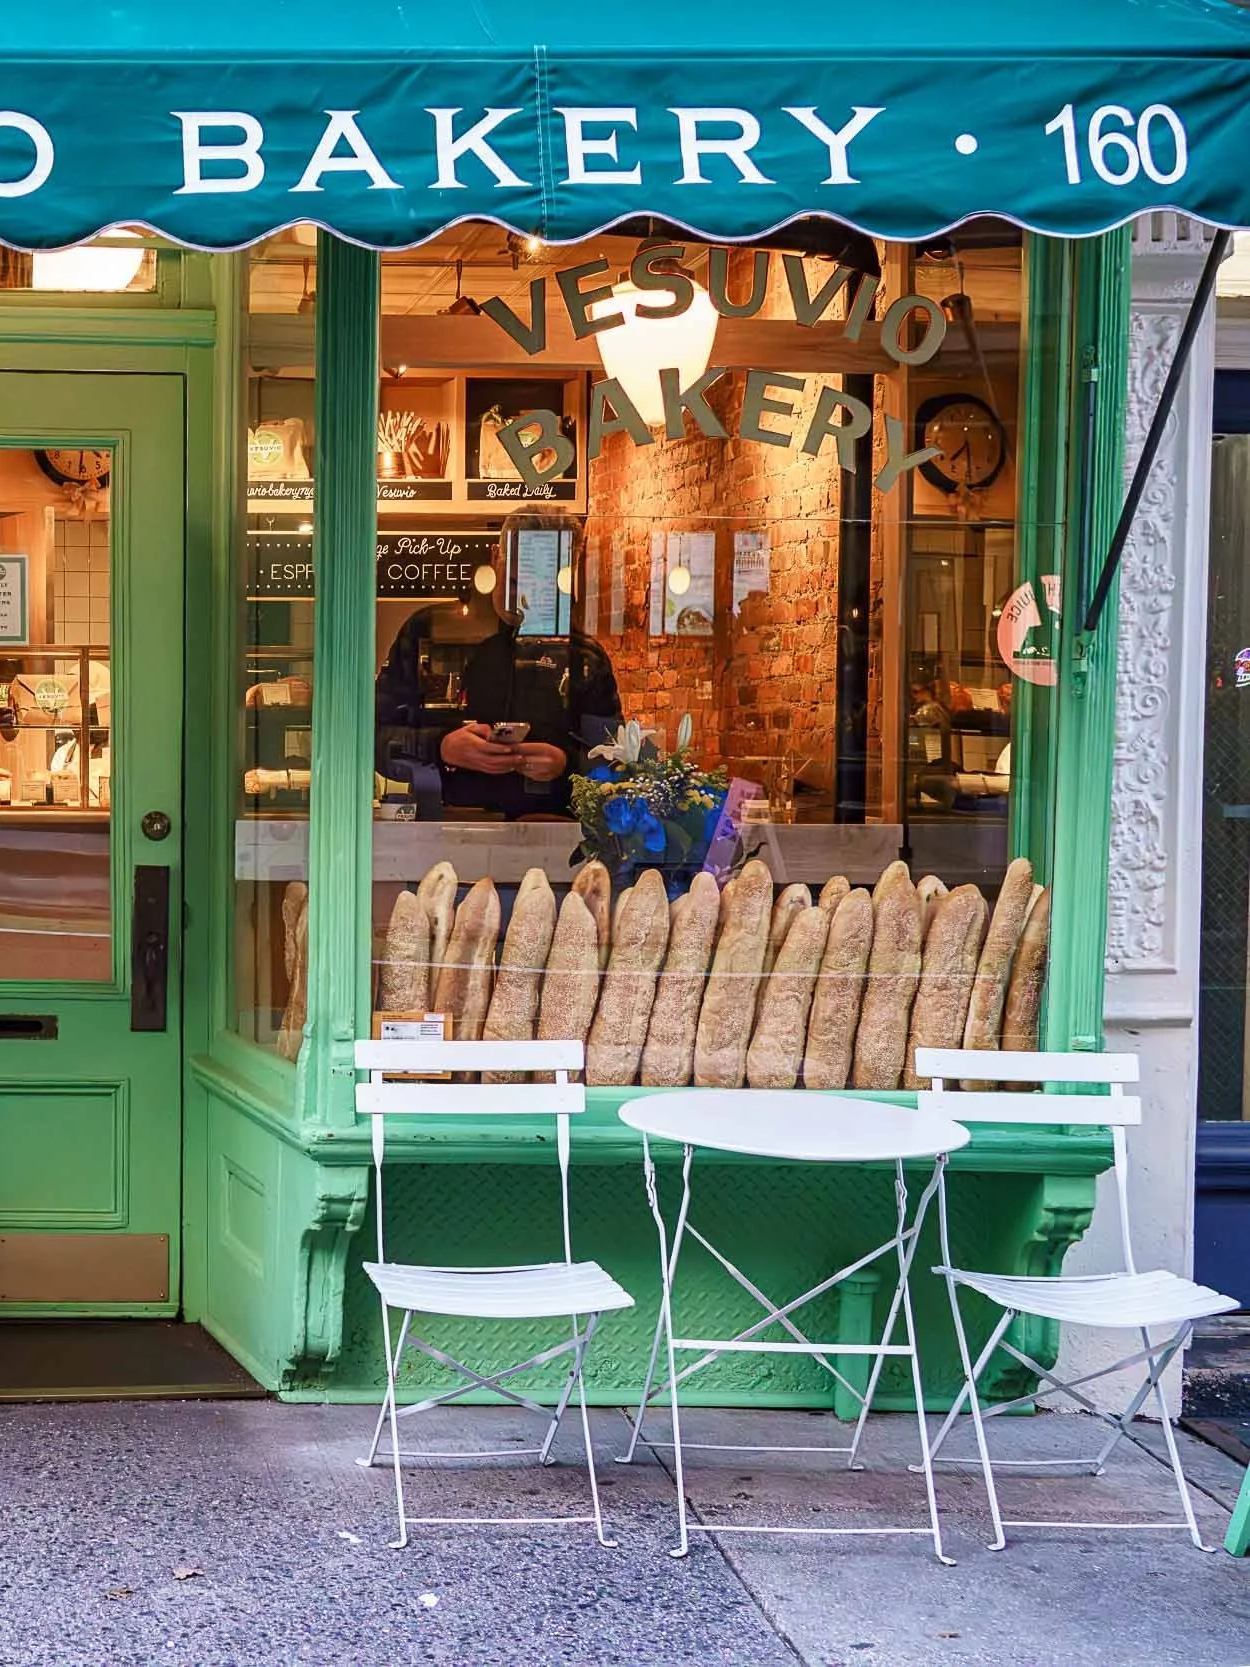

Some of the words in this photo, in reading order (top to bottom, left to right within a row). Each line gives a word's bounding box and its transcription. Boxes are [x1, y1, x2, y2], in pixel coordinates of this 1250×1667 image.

[170, 106, 886, 194] BAKERY
[1045, 104, 1187, 186] 160
[479, 245, 947, 366] VESUVIO
[495, 364, 944, 494] BAKERY
[377, 485, 417, 499] Vesuvio
[486, 483, 520, 498] Baked
[394, 537, 462, 559] Pick-Up
[388, 564, 472, 581] COFFEE
